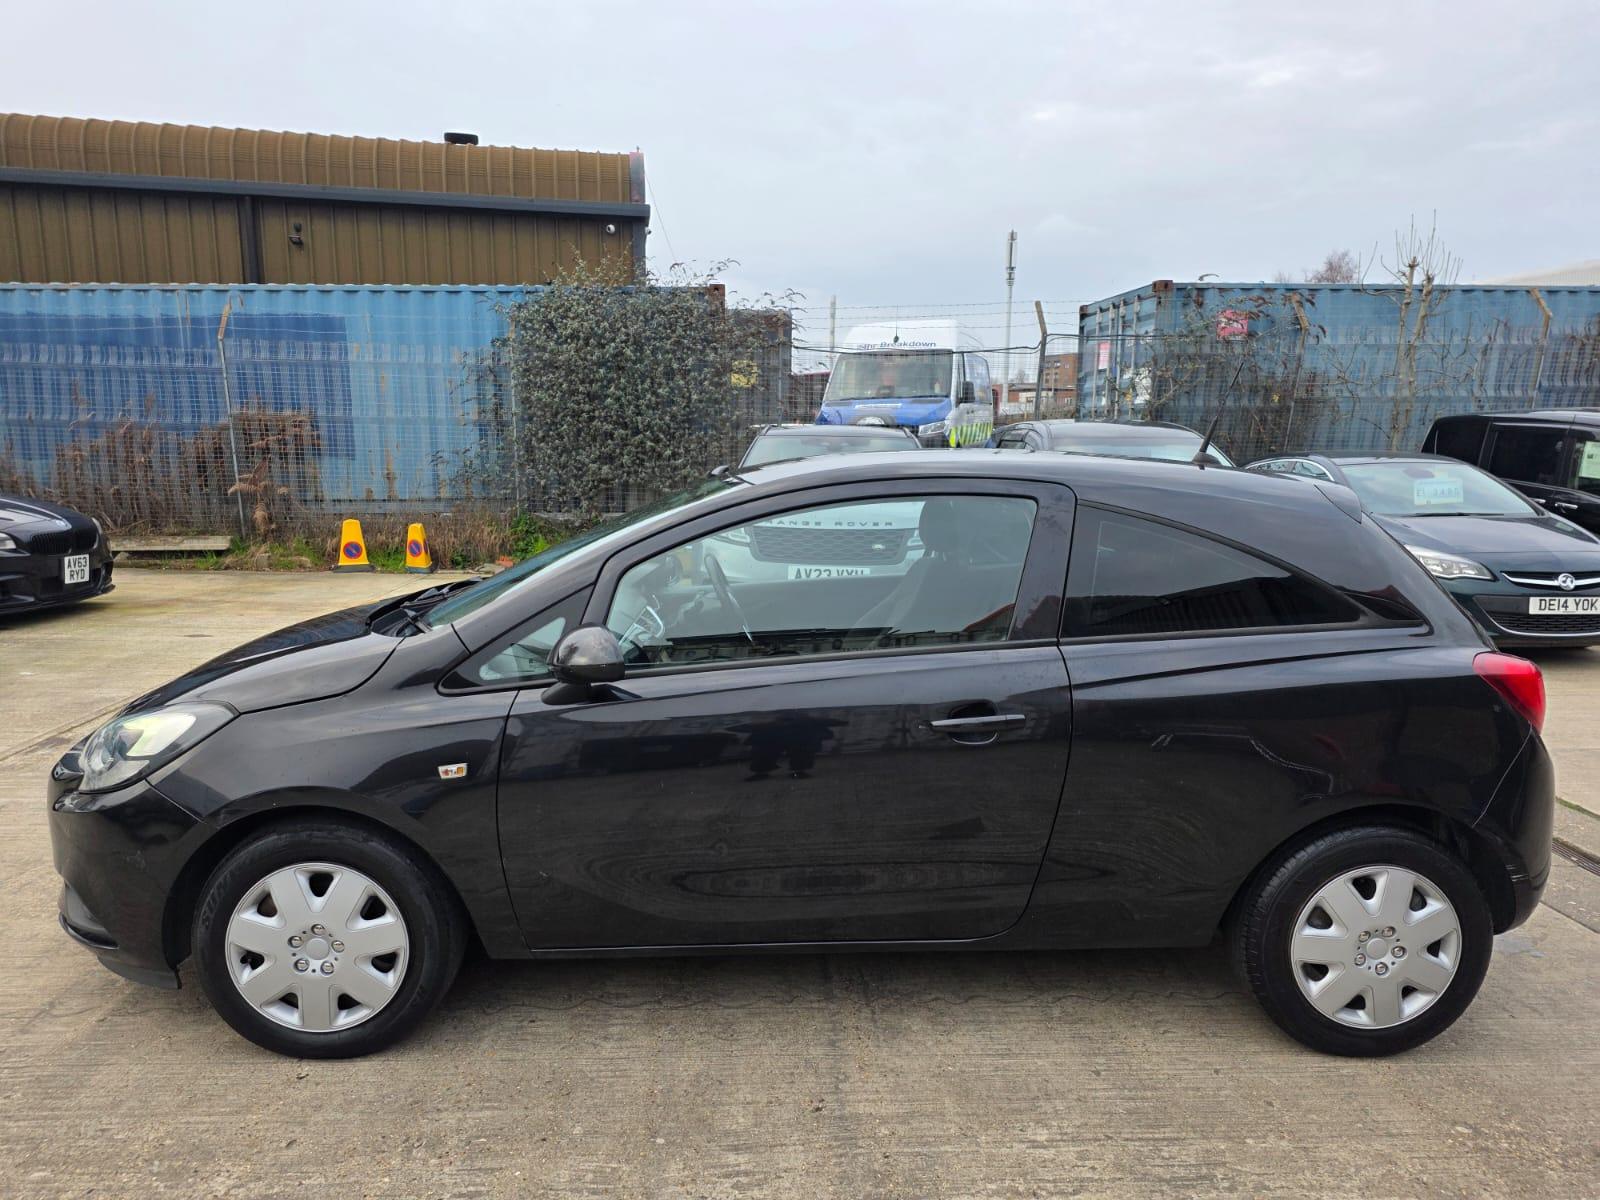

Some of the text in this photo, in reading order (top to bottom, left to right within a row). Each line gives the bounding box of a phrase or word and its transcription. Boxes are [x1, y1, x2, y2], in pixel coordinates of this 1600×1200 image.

[67, 556, 88, 569] AV63
[69, 568, 85, 581] RYD
[1538, 598, 1599, 611] DE14 YOK
